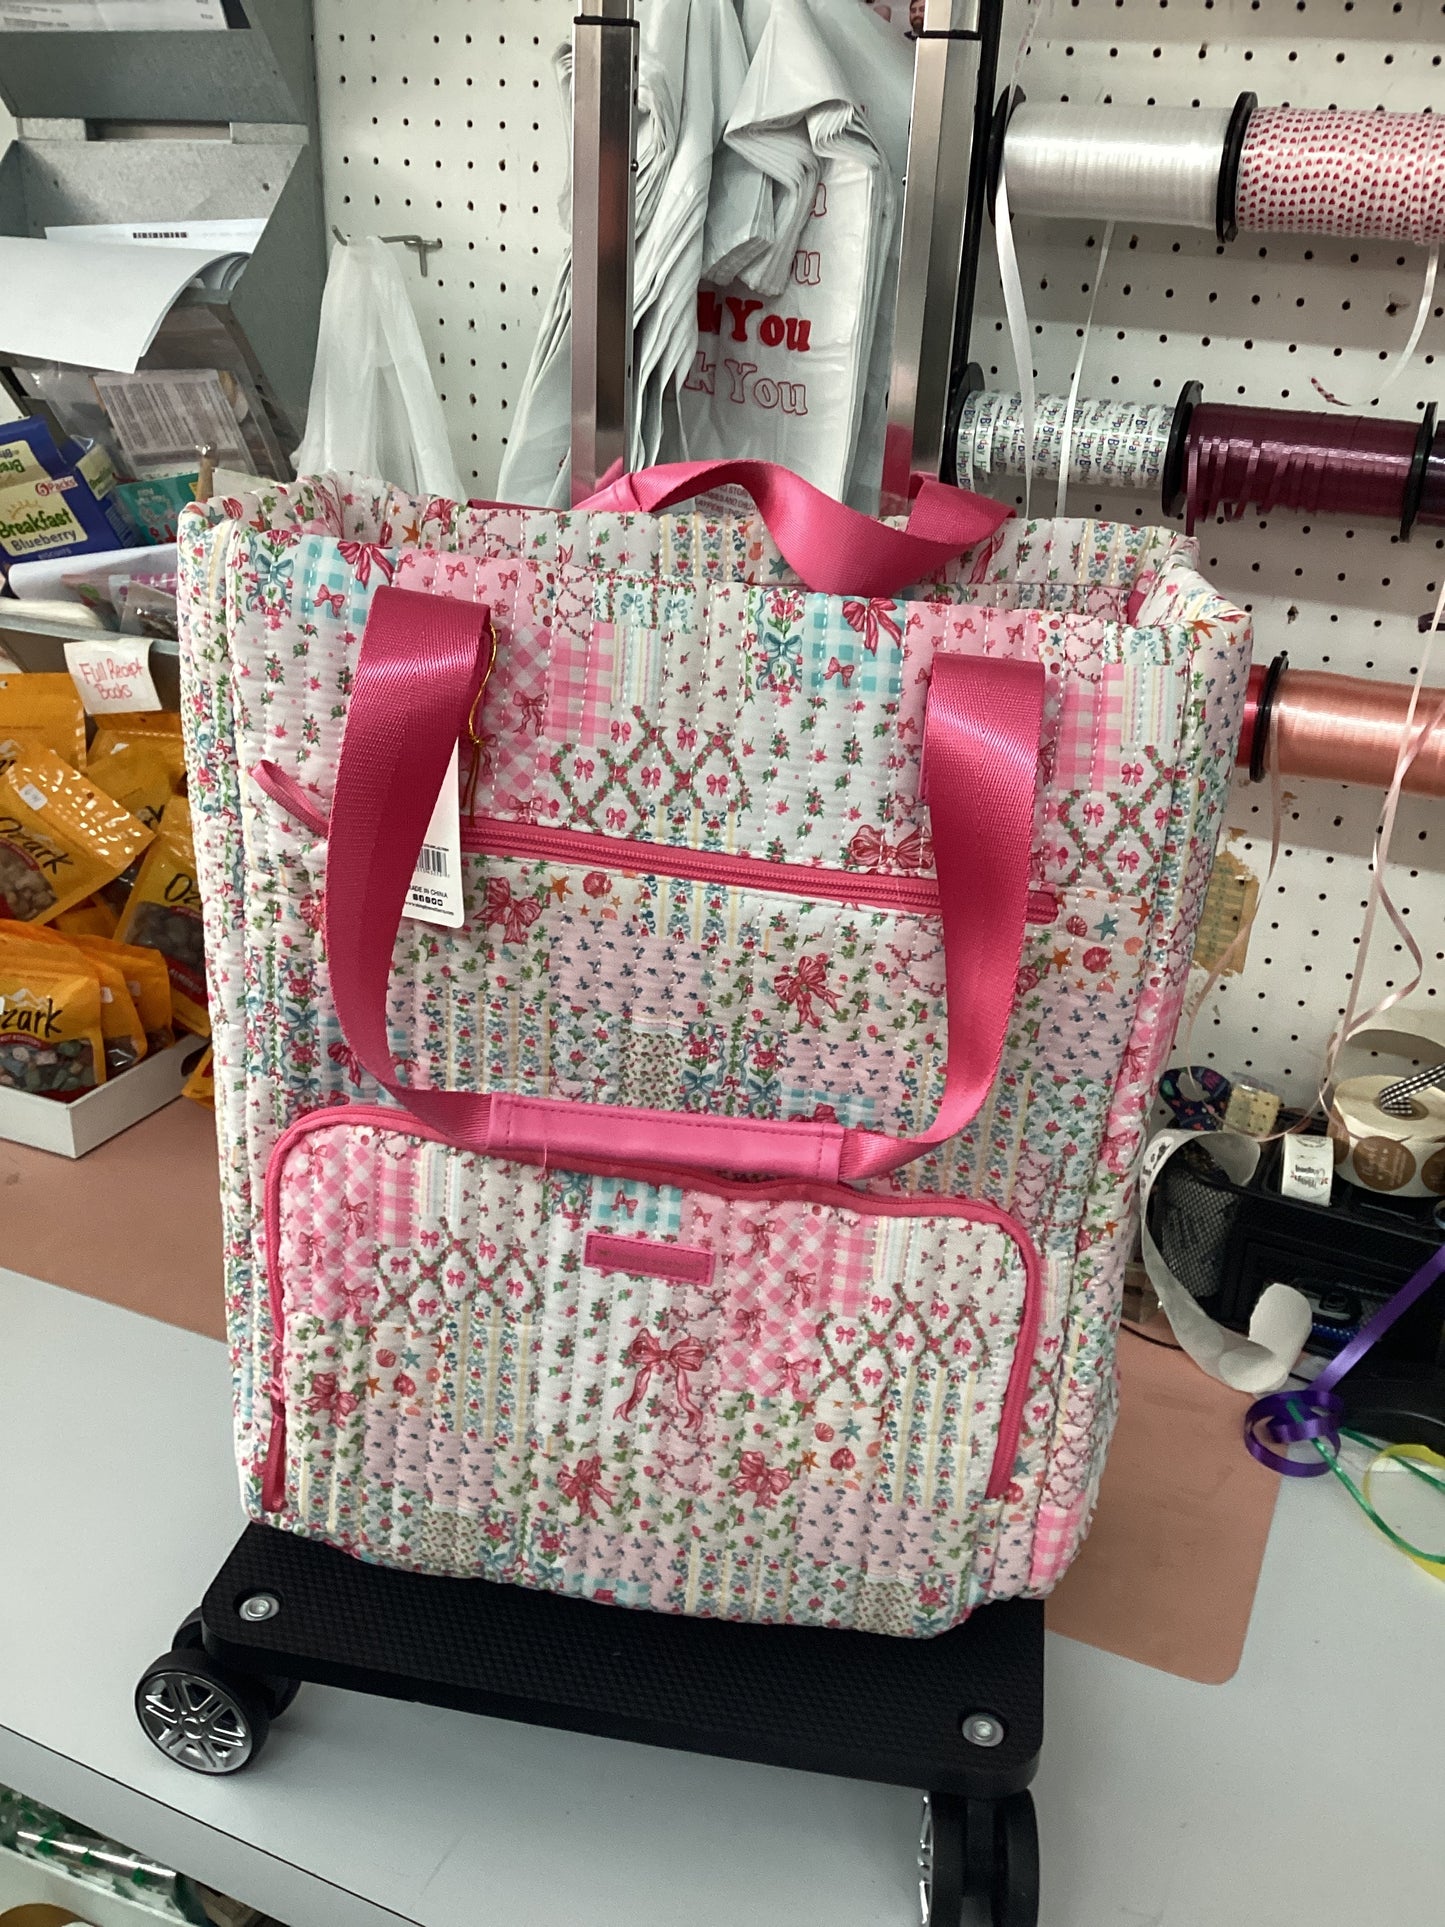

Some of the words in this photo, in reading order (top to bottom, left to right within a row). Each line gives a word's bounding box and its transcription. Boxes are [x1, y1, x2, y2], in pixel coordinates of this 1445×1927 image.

[725, 296, 811, 352] You
[724, 359, 808, 415] You
[0, 508, 73, 539] Breakfast
[10, 530, 77, 551] Blueberry
[79, 662, 107, 684] Full
[94, 683, 133, 700] Books
[430, 889, 449, 898] CHINA
[0, 998, 63, 1038] zark
